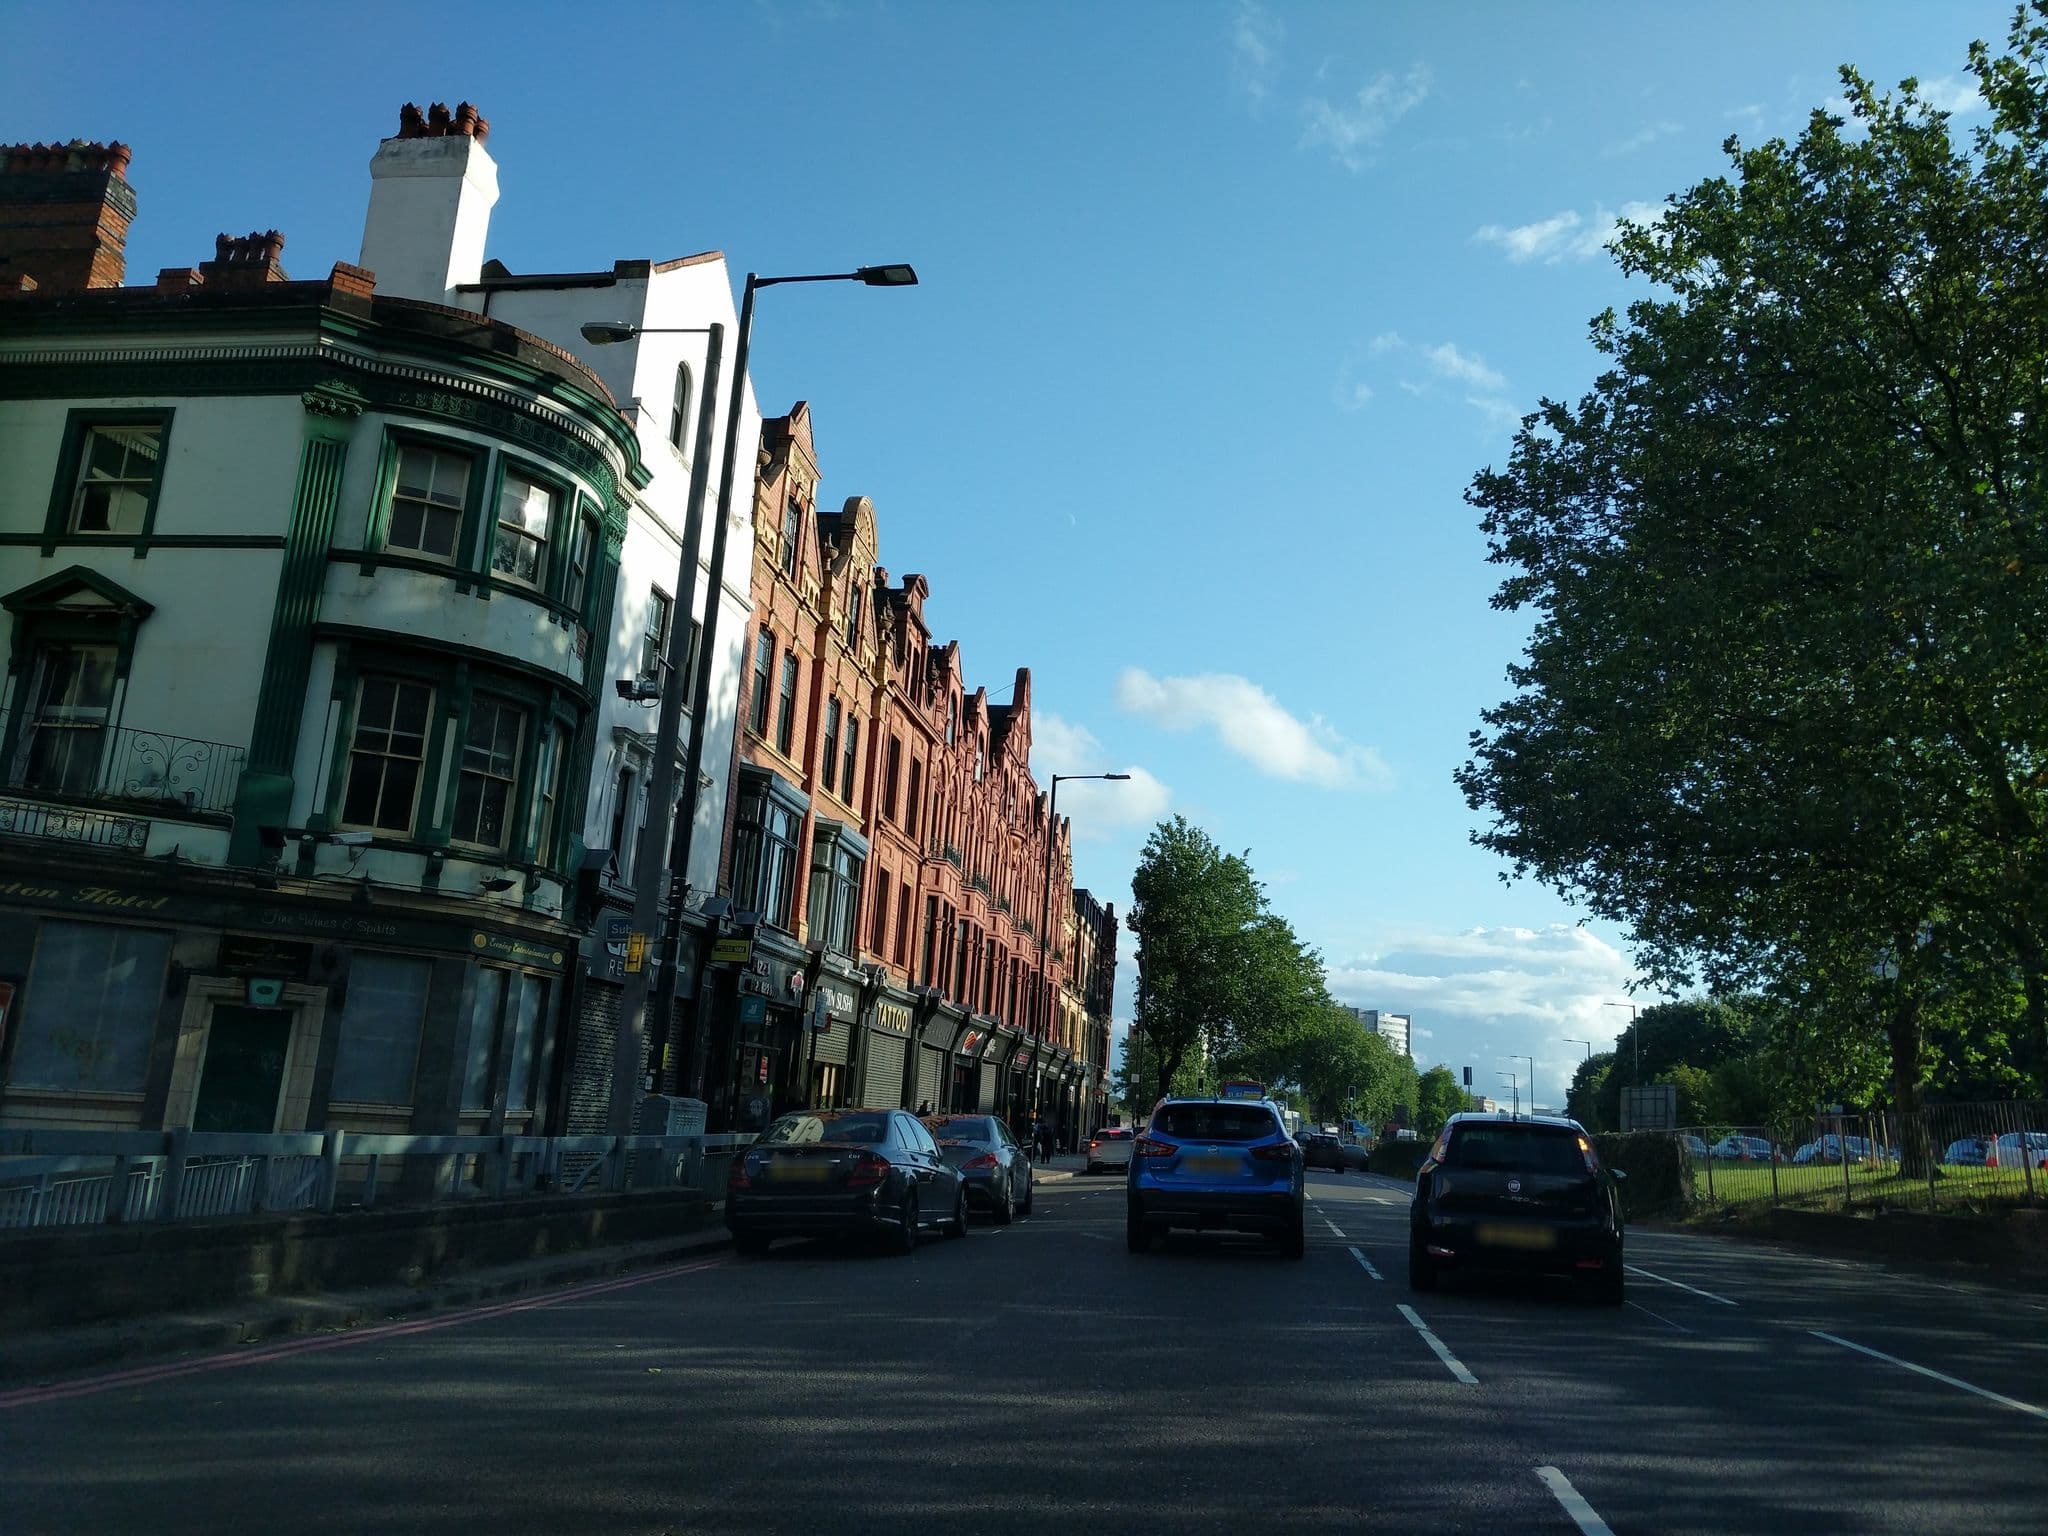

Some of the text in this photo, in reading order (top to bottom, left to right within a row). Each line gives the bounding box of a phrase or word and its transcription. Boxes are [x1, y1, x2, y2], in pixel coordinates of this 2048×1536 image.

[72, 886, 169, 910] Hotel
[302, 911, 337, 929] Wines
[356, 920, 400, 937] Spirits
[836, 992, 853, 1013] SUSHI
[877, 1001, 909, 1032] TATTOO
